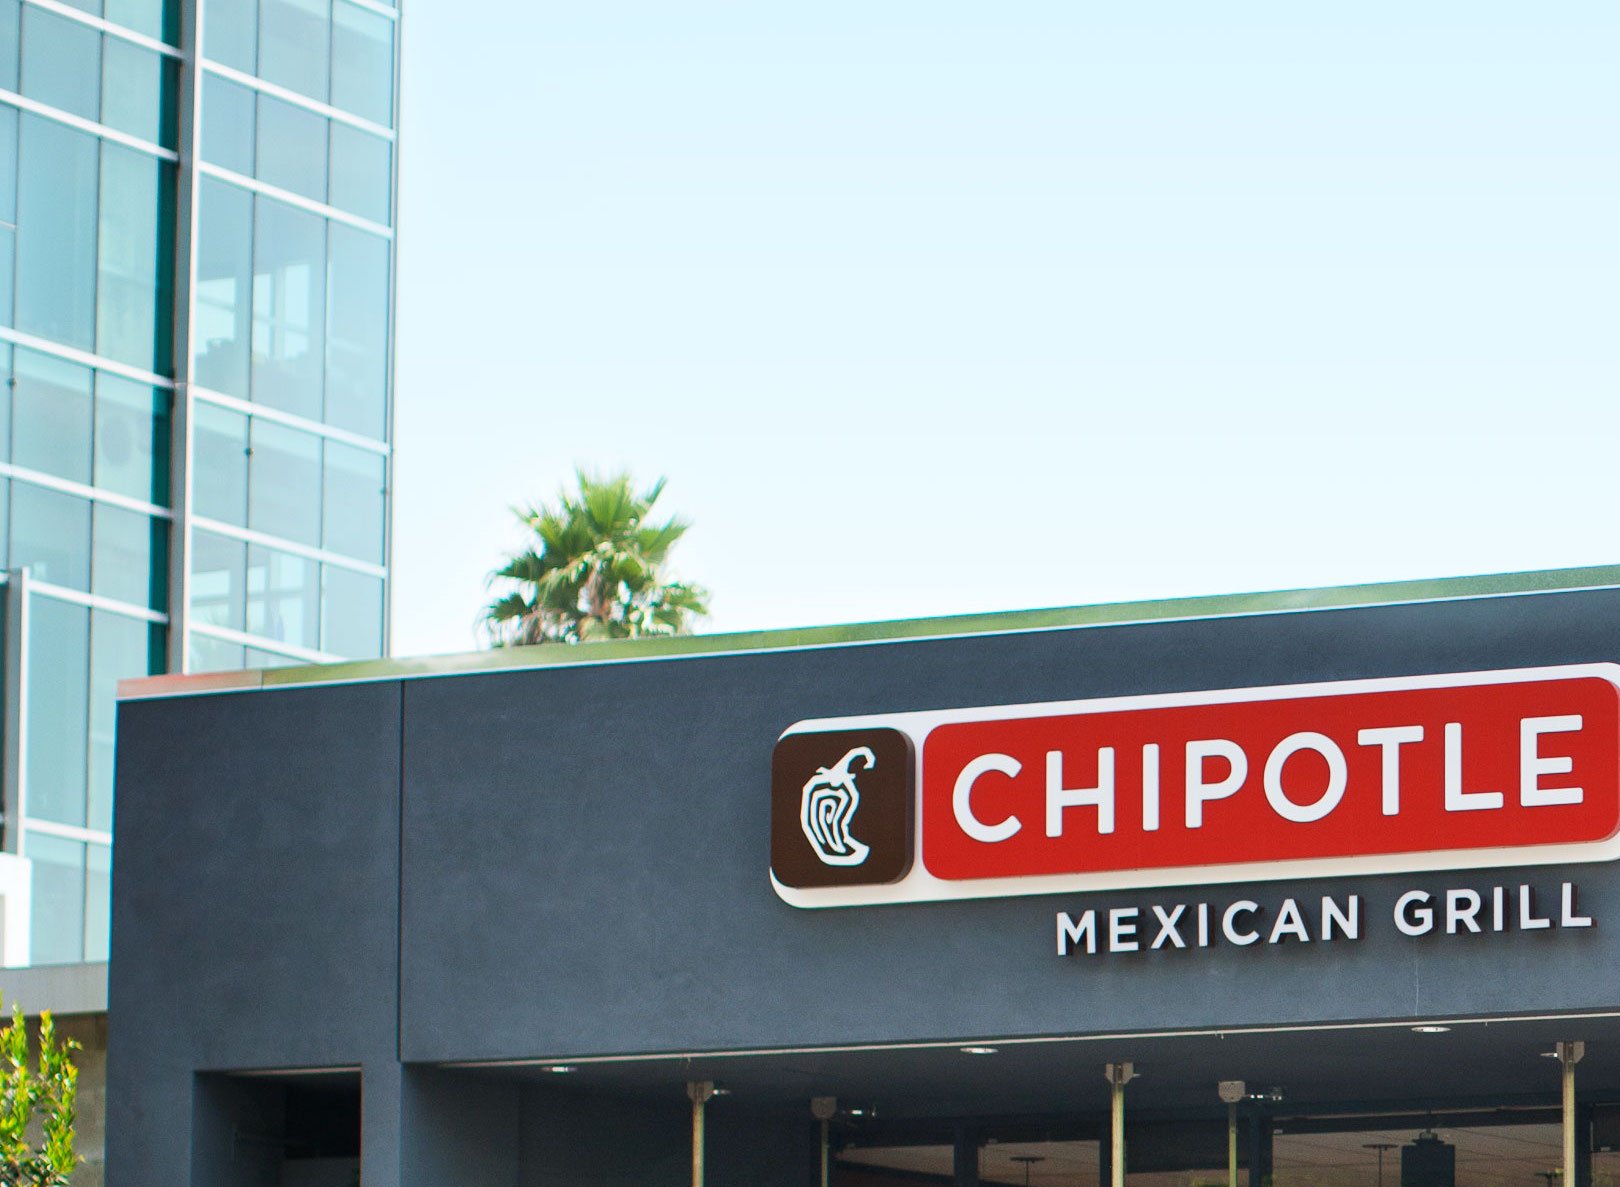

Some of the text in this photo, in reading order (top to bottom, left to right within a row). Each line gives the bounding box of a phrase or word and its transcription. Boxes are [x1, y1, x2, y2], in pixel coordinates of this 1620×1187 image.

[951, 713, 1584, 844] CHIPOTLE
[1055, 881, 1594, 957] MEXICAN GRILL
